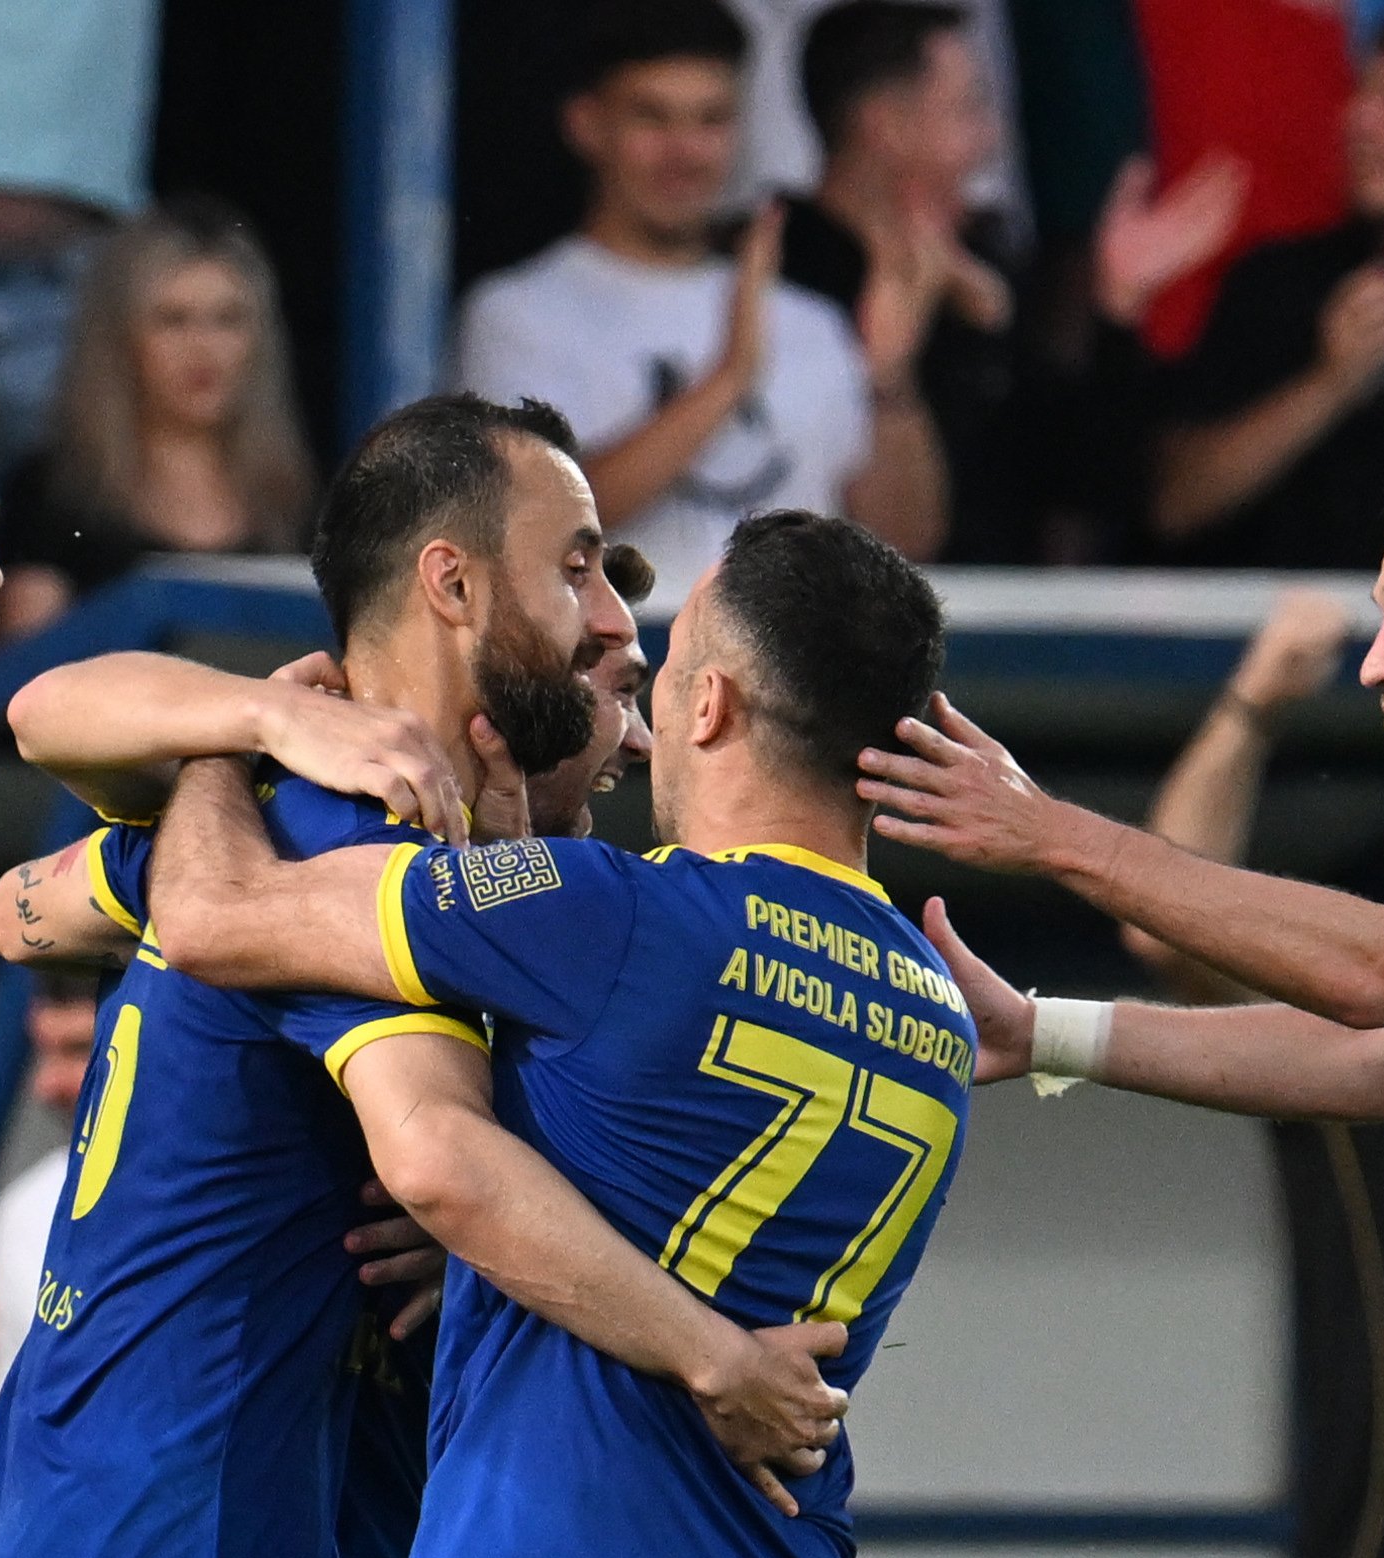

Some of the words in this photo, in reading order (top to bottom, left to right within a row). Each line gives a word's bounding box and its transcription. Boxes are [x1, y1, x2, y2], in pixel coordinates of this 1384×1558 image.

[745, 894, 881, 981] PREMIER
[866, 1001, 974, 1093] SLOBOZIA
[659, 1014, 958, 1326] 77
